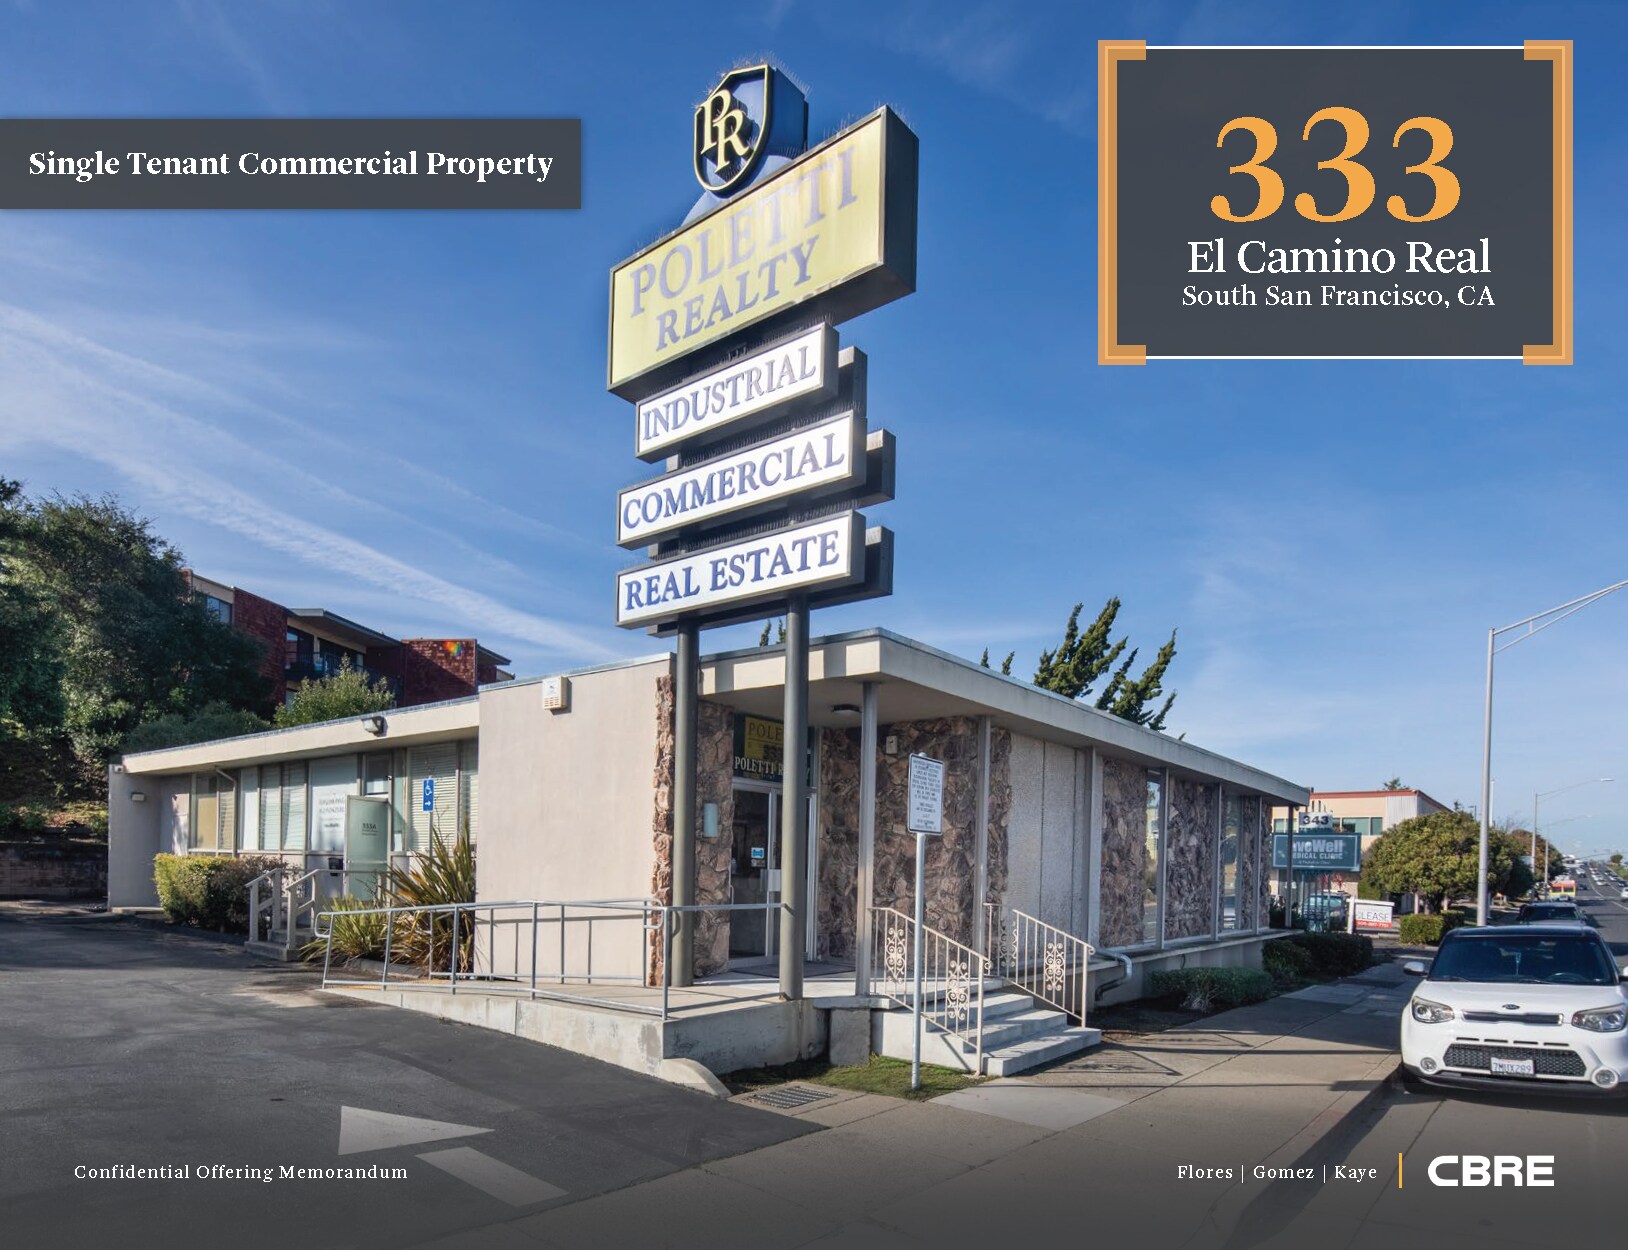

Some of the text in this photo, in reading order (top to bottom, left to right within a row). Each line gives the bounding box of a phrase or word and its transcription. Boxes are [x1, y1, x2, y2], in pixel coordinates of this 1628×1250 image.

[629, 146, 858, 318] POLETTI
[655, 234, 820, 351] REALTY
[642, 346, 816, 441] INDUSTRIAL
[623, 433, 845, 529] COMMERCIAL
[625, 530, 840, 611] REAL ESTATE
[748, 722, 784, 740] POLE
[734, 756, 775, 775] POLETTI
[1302, 815, 1330, 826] 343
[1291, 852, 1317, 860] EDICAL
[1361, 911, 1390, 922] LEASE
